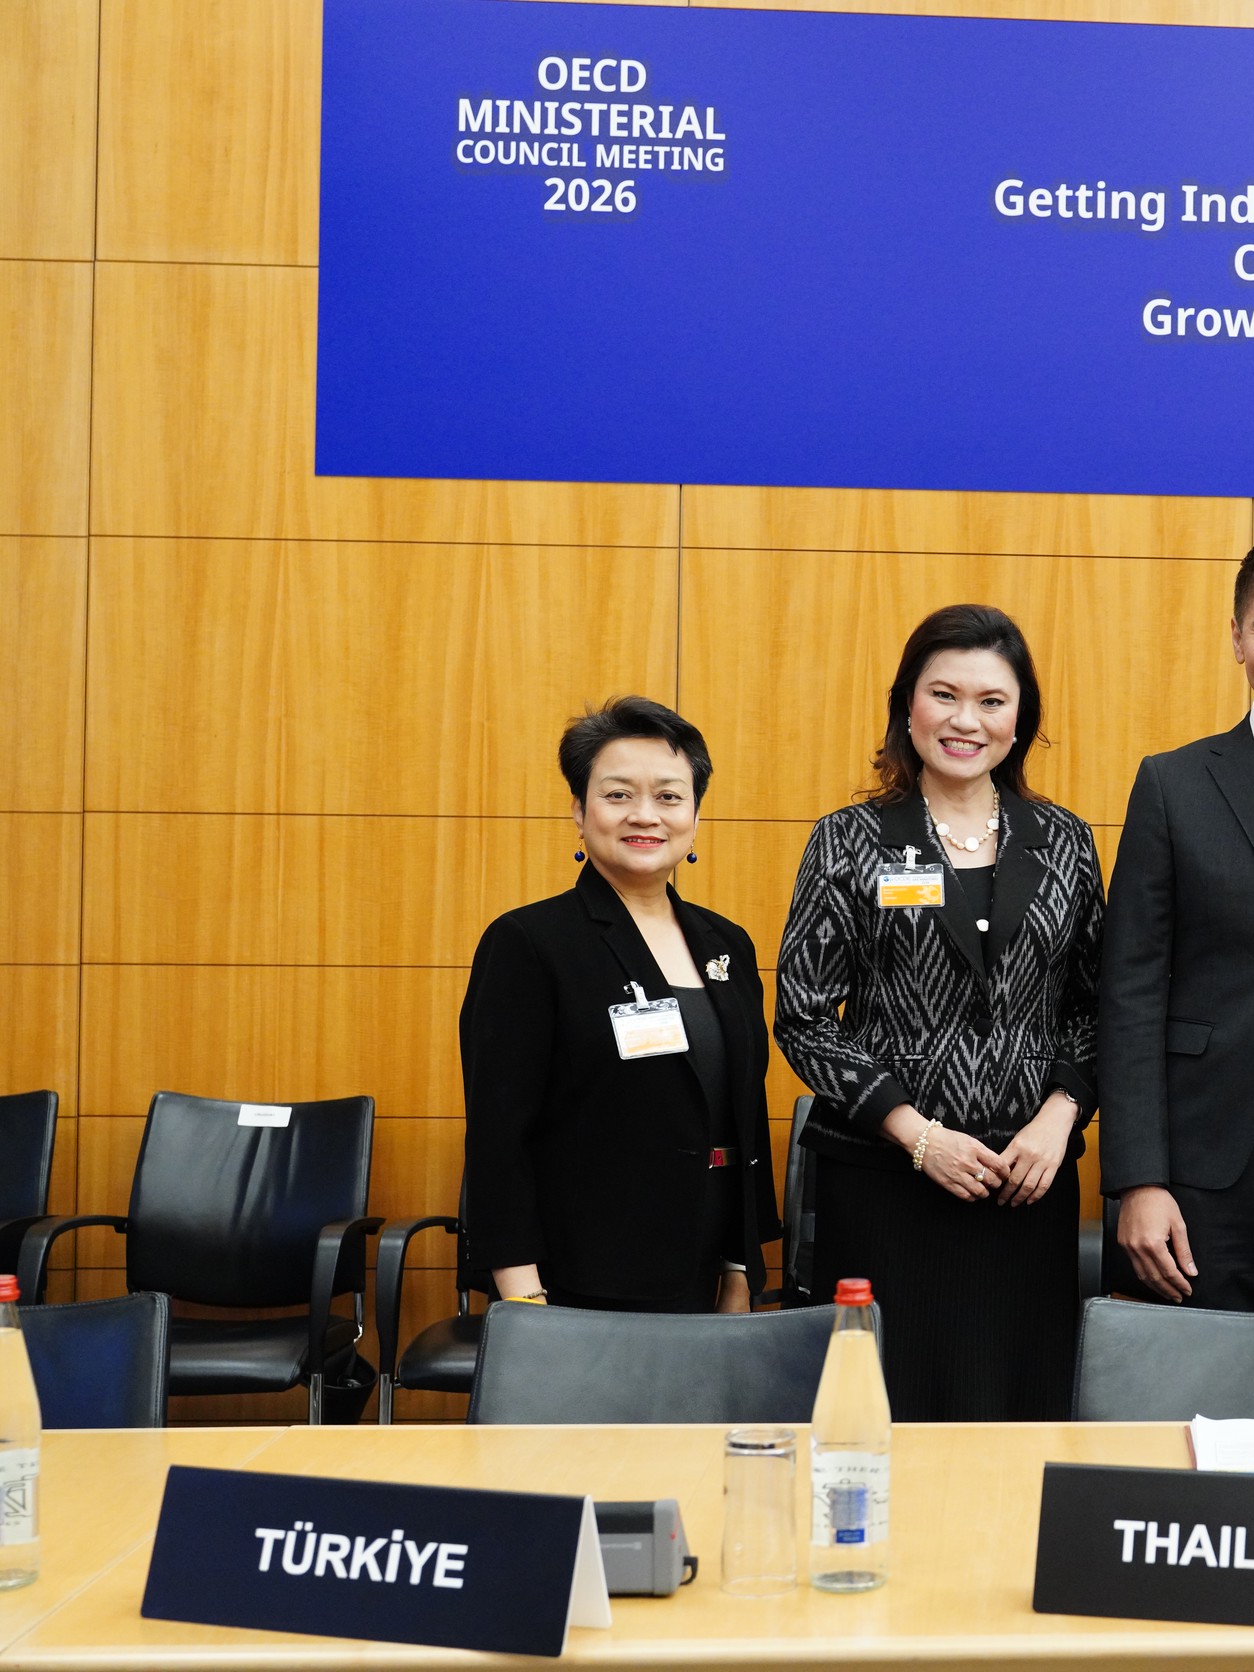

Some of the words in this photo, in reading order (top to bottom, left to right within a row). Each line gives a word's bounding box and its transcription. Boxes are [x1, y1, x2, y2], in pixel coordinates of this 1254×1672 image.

[537, 56, 647, 93] OECD
[458, 98, 726, 140] MINISTERIAL
[456, 139, 587, 167] COUNCIL
[595, 143, 726, 172] MEETING
[543, 177, 637, 213] 2026
[994, 178, 1166, 232] Getting
[255, 1521, 469, 1589] TÜRKİYE
